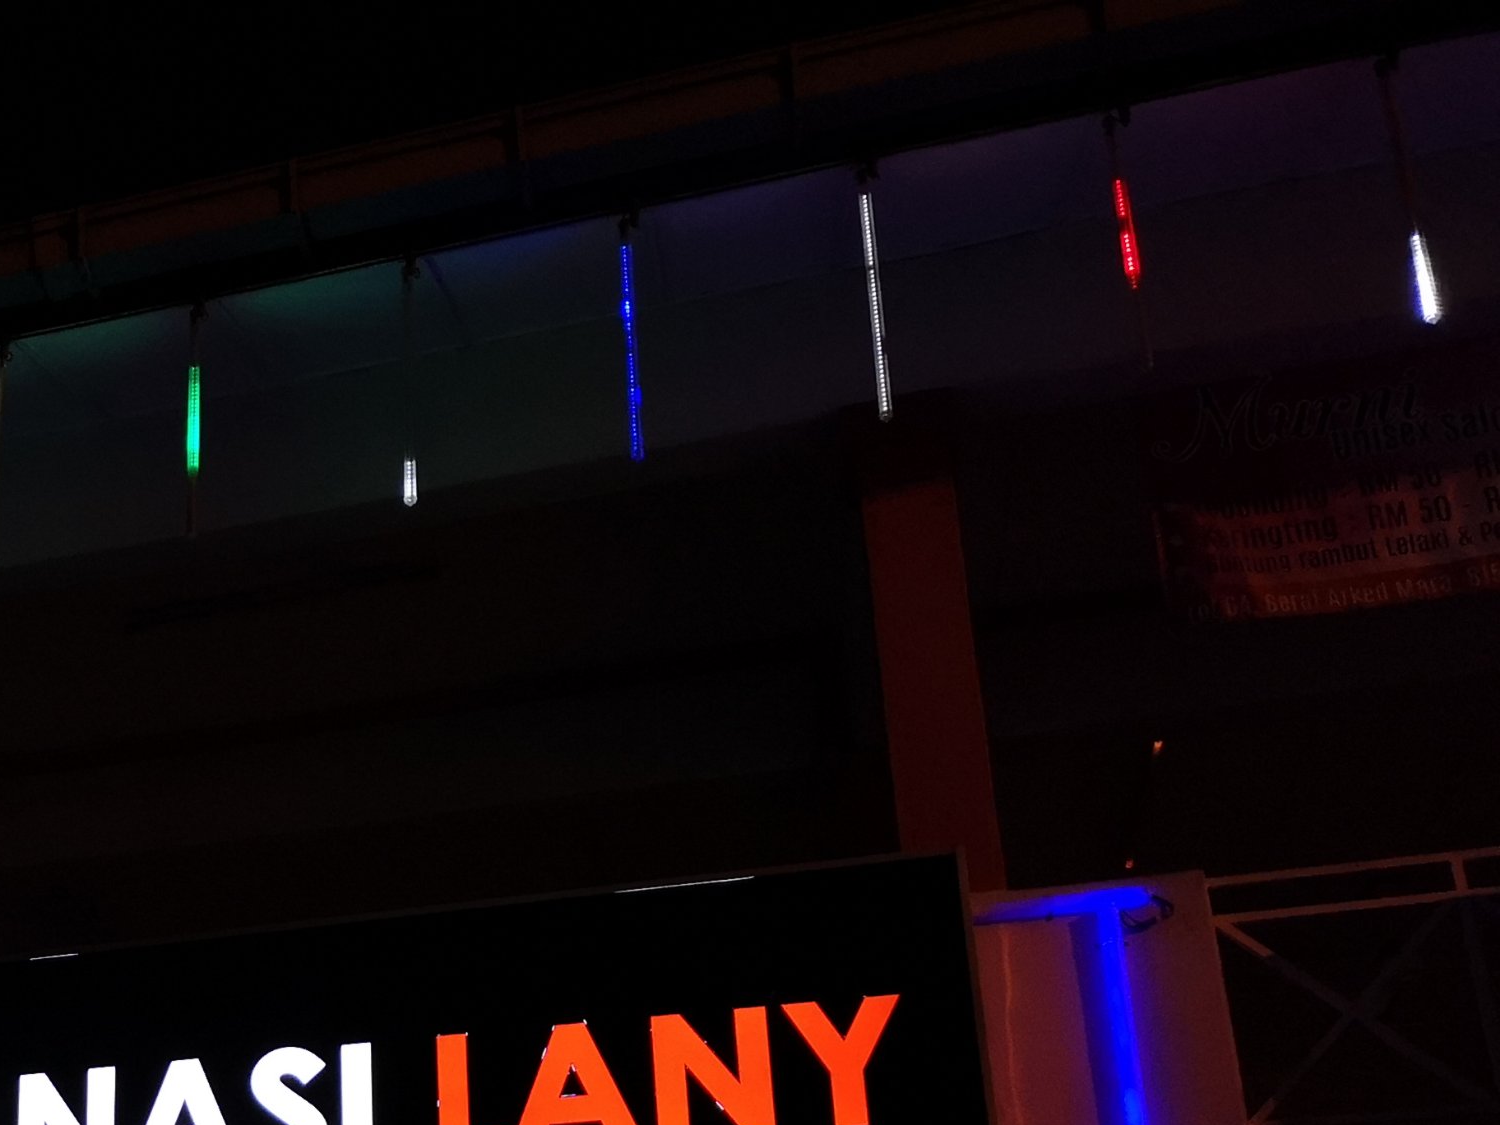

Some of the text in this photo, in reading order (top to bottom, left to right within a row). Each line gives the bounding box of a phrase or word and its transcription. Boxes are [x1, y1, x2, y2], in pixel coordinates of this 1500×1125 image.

[1332, 418, 1430, 460] Unisex
[1367, 501, 1409, 531] RM
[1419, 495, 1452, 524] 50
